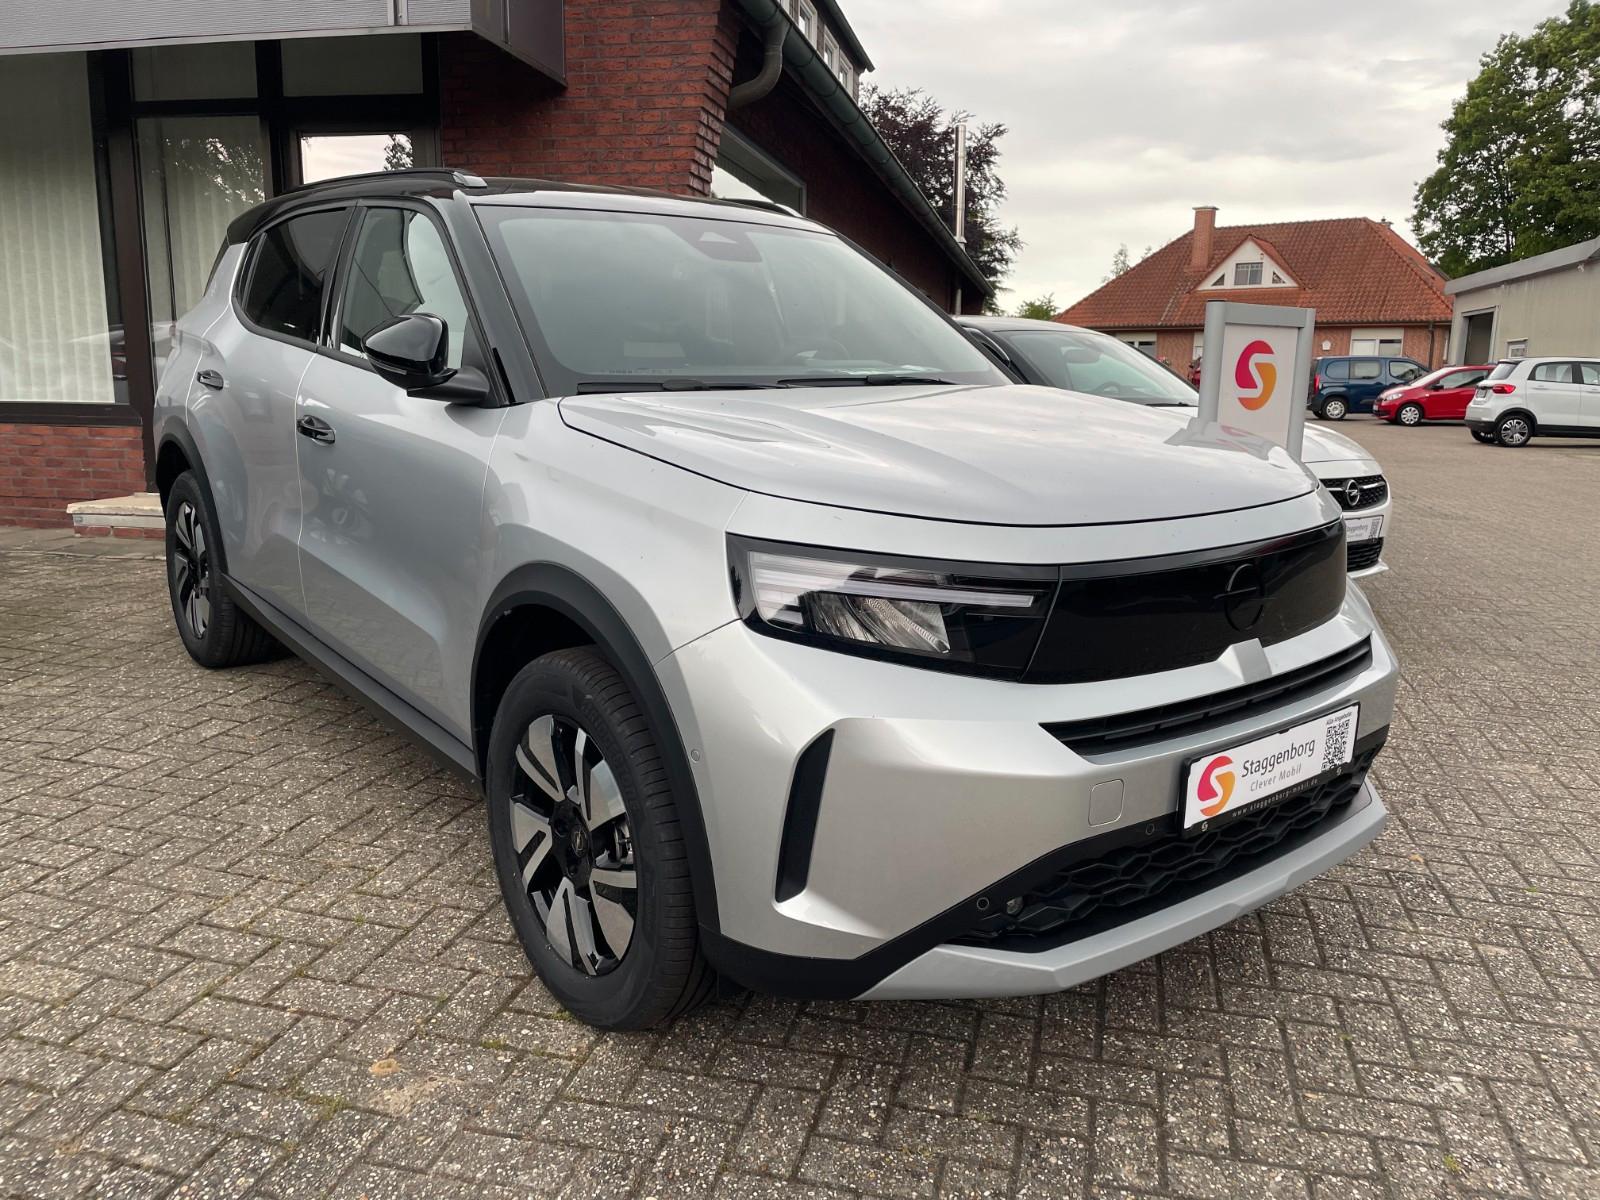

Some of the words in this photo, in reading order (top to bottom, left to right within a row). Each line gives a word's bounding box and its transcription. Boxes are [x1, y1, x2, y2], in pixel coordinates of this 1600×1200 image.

[1241, 739, 1316, 778] Staggenborg
[1250, 775, 1277, 792] Clever
[1279, 763, 1302, 780] Mobil
